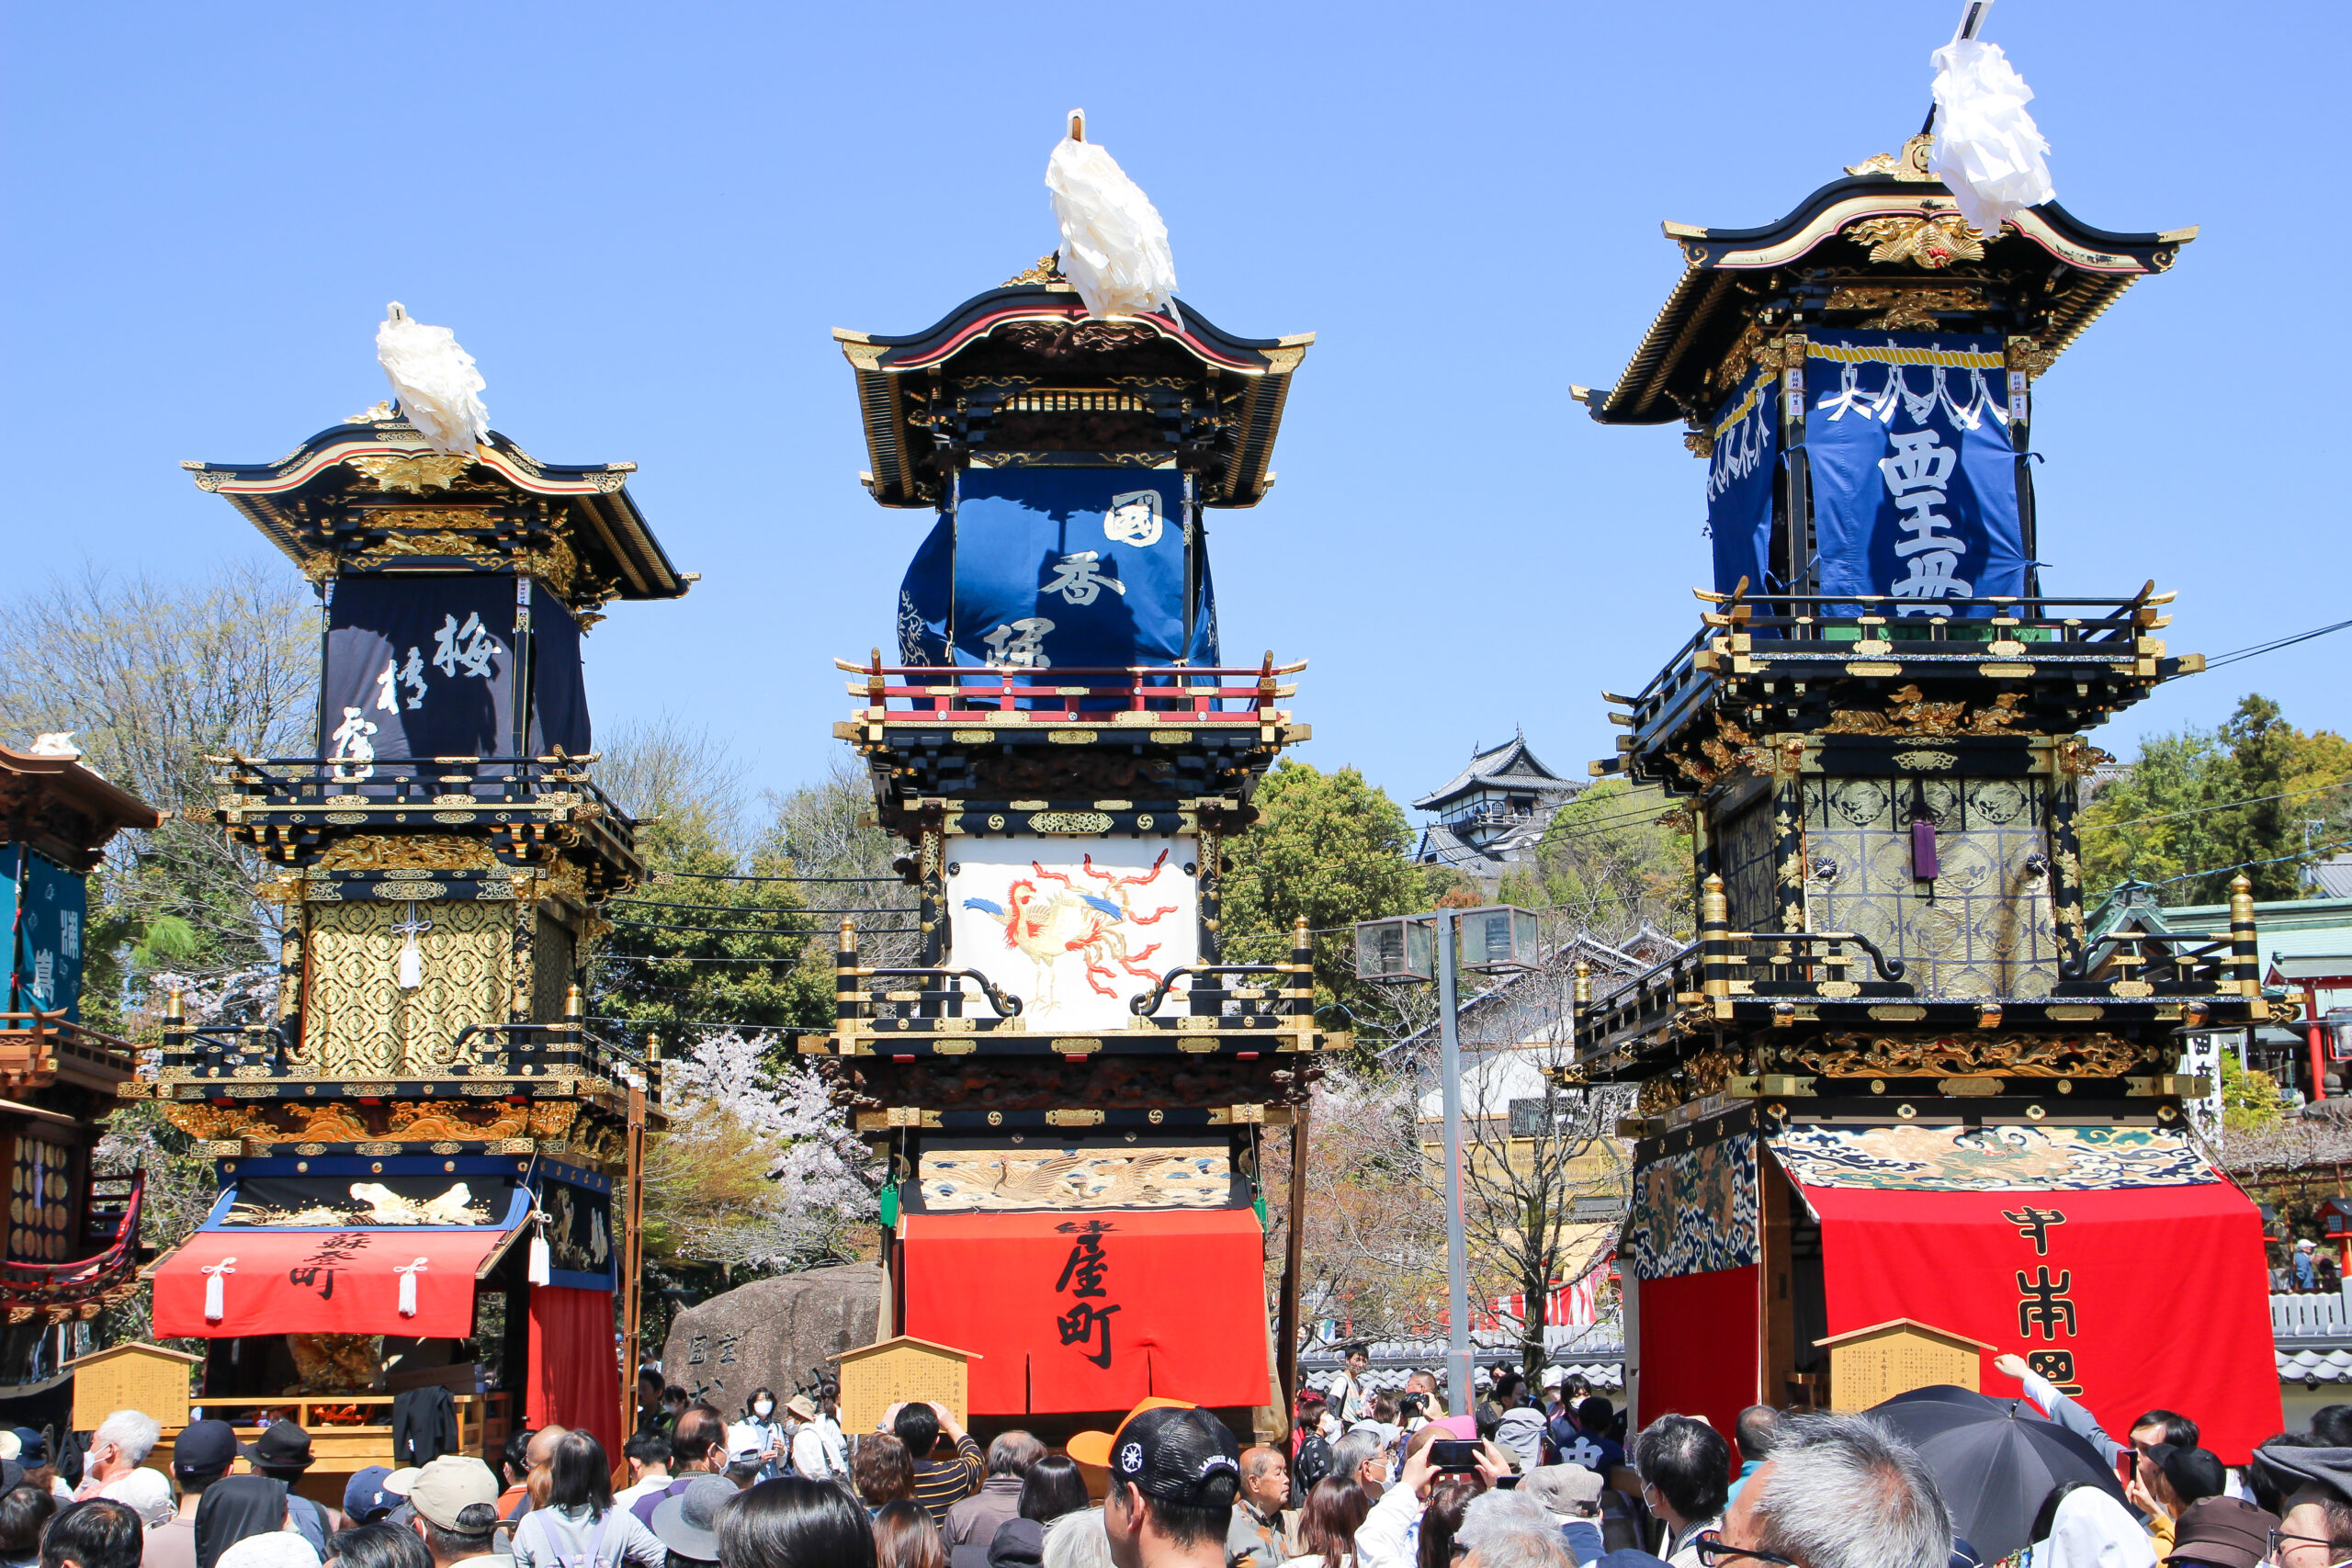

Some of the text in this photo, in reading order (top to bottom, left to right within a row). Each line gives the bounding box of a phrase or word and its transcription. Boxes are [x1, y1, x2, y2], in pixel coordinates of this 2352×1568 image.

[1877, 428, 1973, 618] 西王母
[688, 1333, 739, 1365] 国宝
